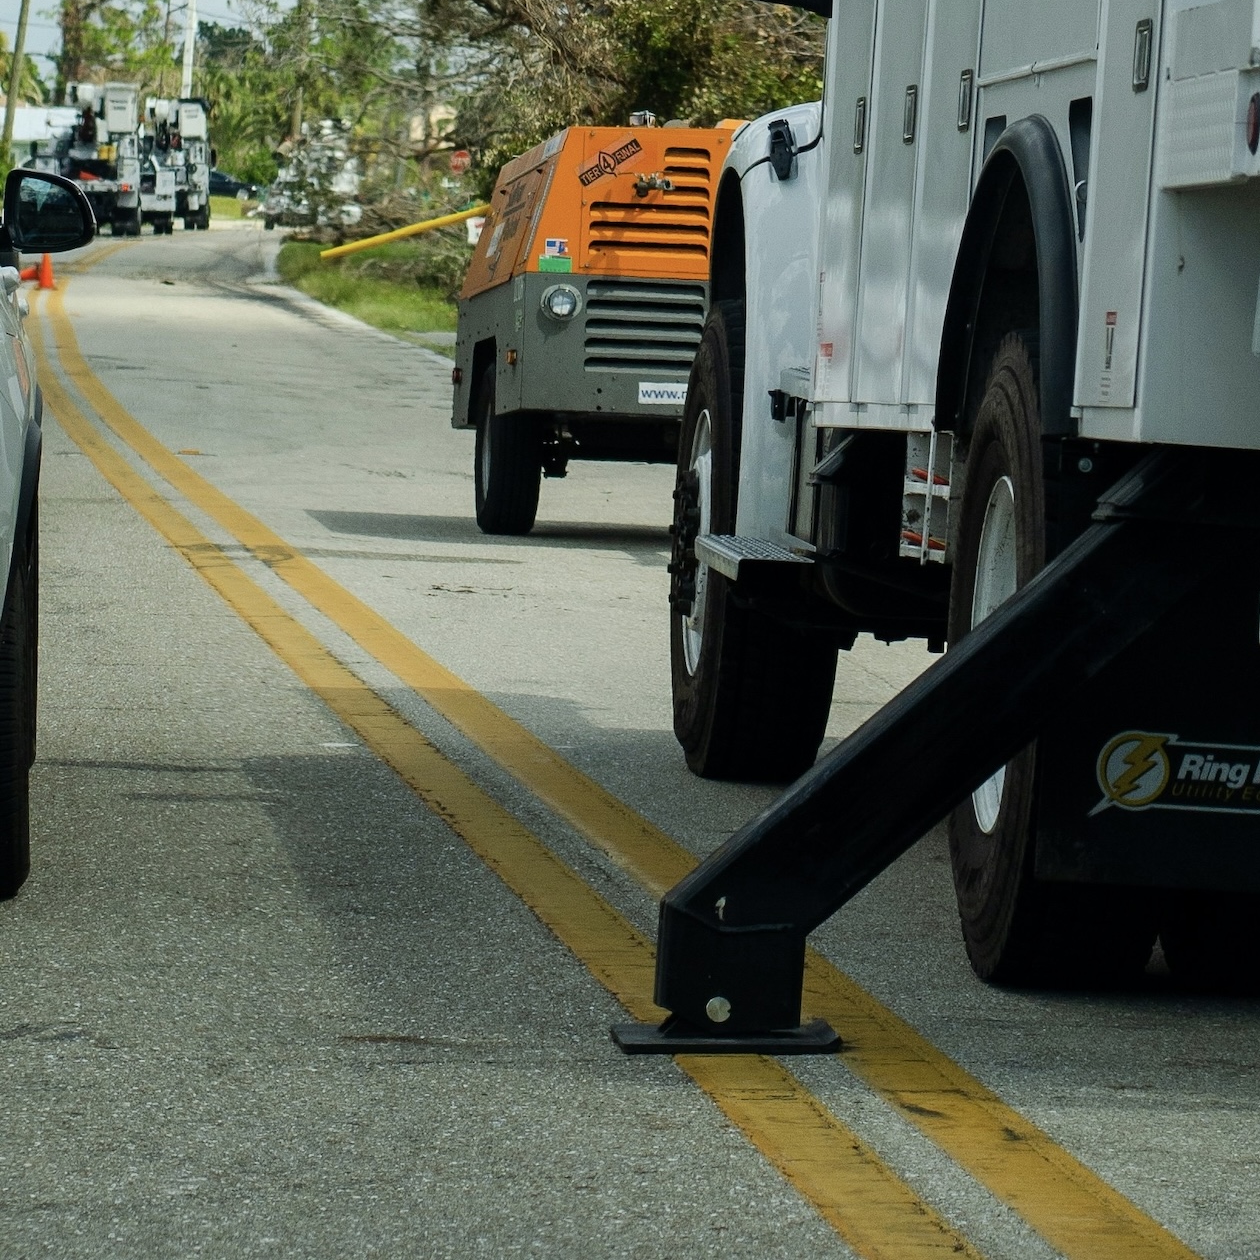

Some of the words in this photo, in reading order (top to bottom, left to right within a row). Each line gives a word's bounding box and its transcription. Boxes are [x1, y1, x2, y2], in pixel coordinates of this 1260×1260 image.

[580, 167, 600, 185] TIER
[602, 155, 615, 171] 4
[615, 142, 640, 161] FINAL
[1177, 754, 1250, 789] Ring
[1172, 782, 1233, 800] Utility
